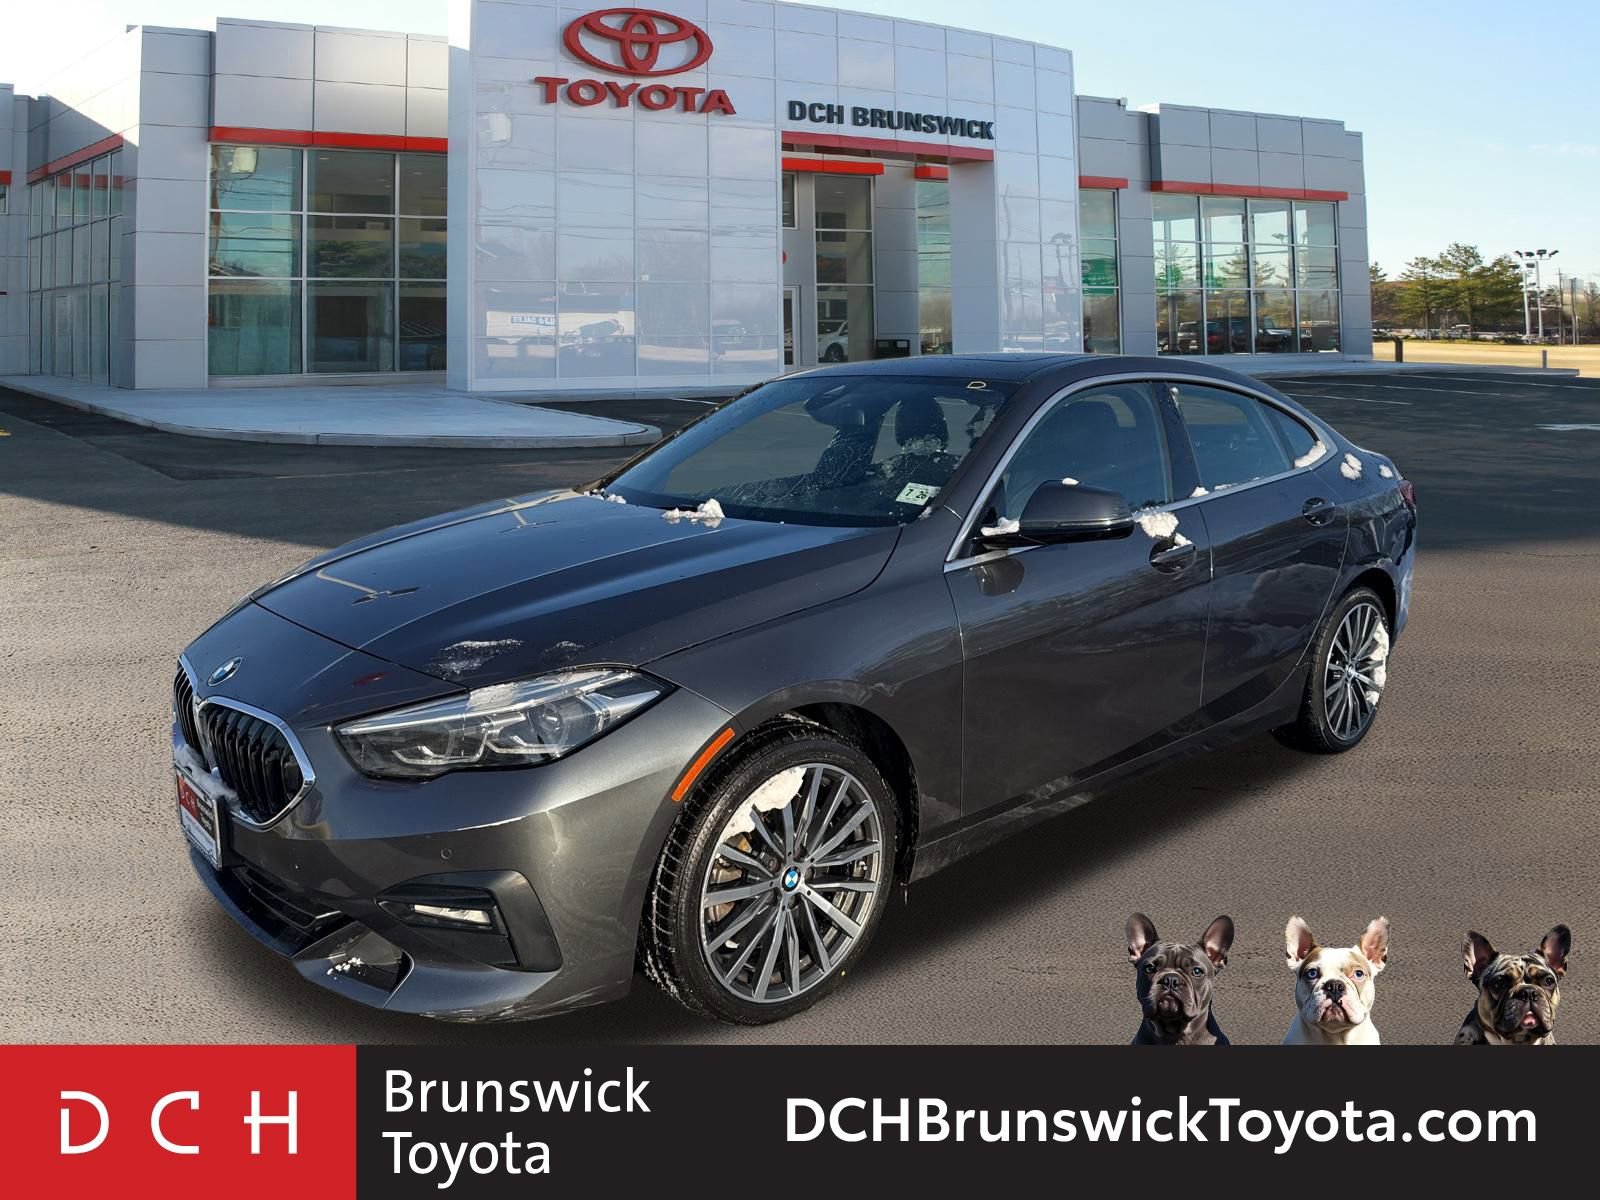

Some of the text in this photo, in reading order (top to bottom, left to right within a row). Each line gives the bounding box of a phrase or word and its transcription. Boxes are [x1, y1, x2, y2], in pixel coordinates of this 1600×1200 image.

[534, 76, 737, 115] TOYOTA
[788, 100, 994, 140] DCH BRUNSWICK
[905, 488, 914, 497] 7
